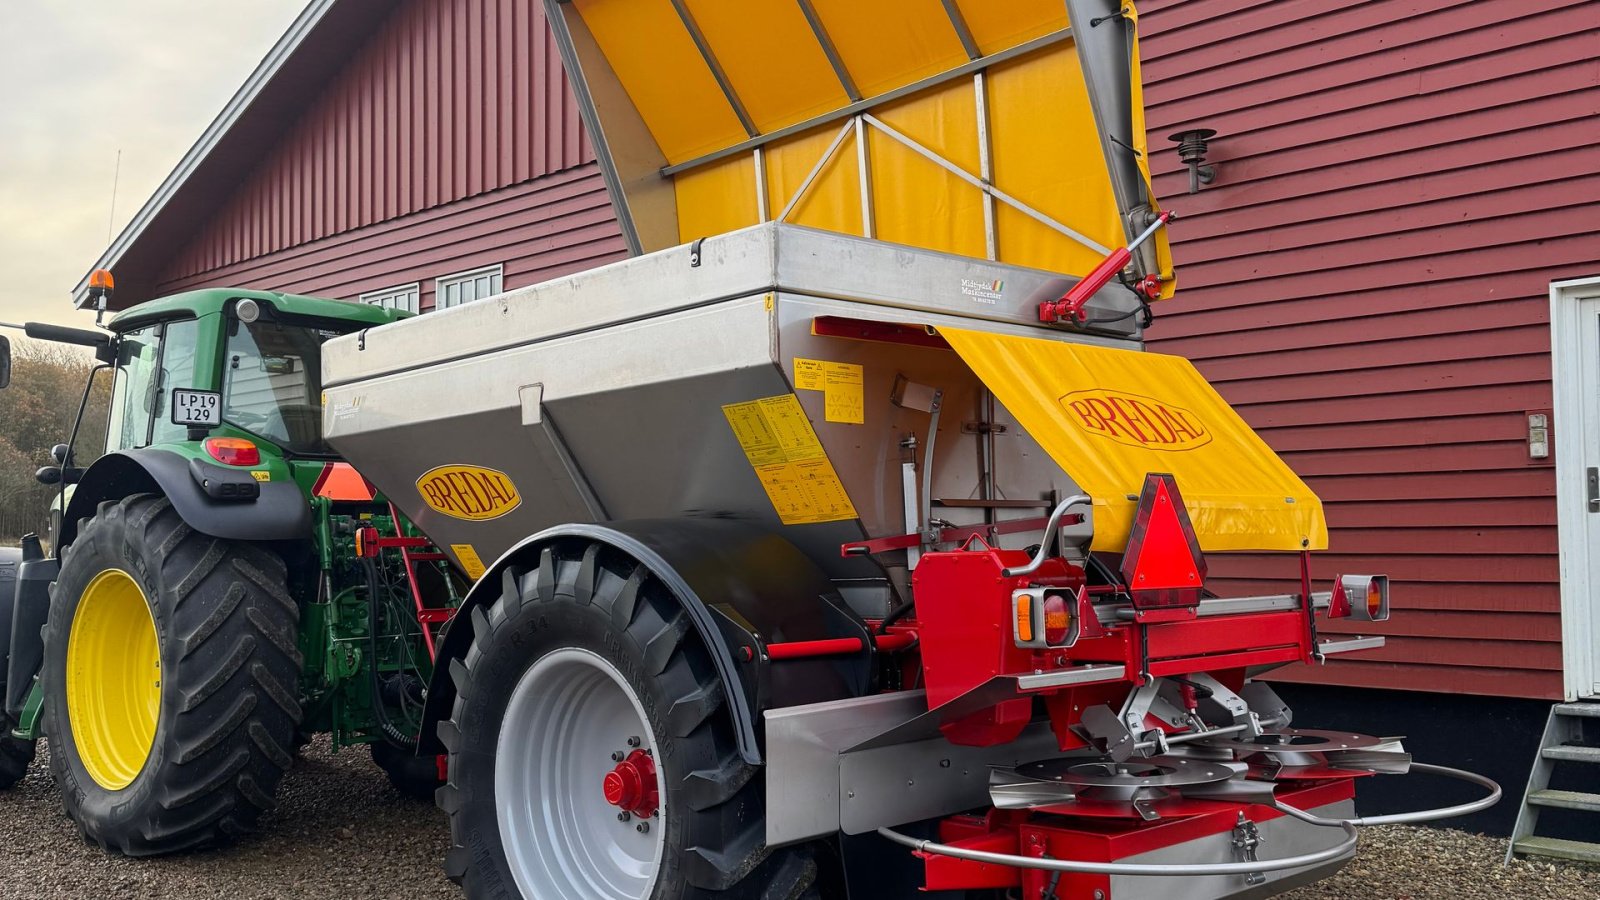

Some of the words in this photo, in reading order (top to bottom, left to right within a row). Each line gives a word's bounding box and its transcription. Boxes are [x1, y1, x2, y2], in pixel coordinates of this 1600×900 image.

[185, 408, 210, 421] 129
[1069, 396, 1205, 446] BREDAL
[422, 471, 516, 517] BREDAL
